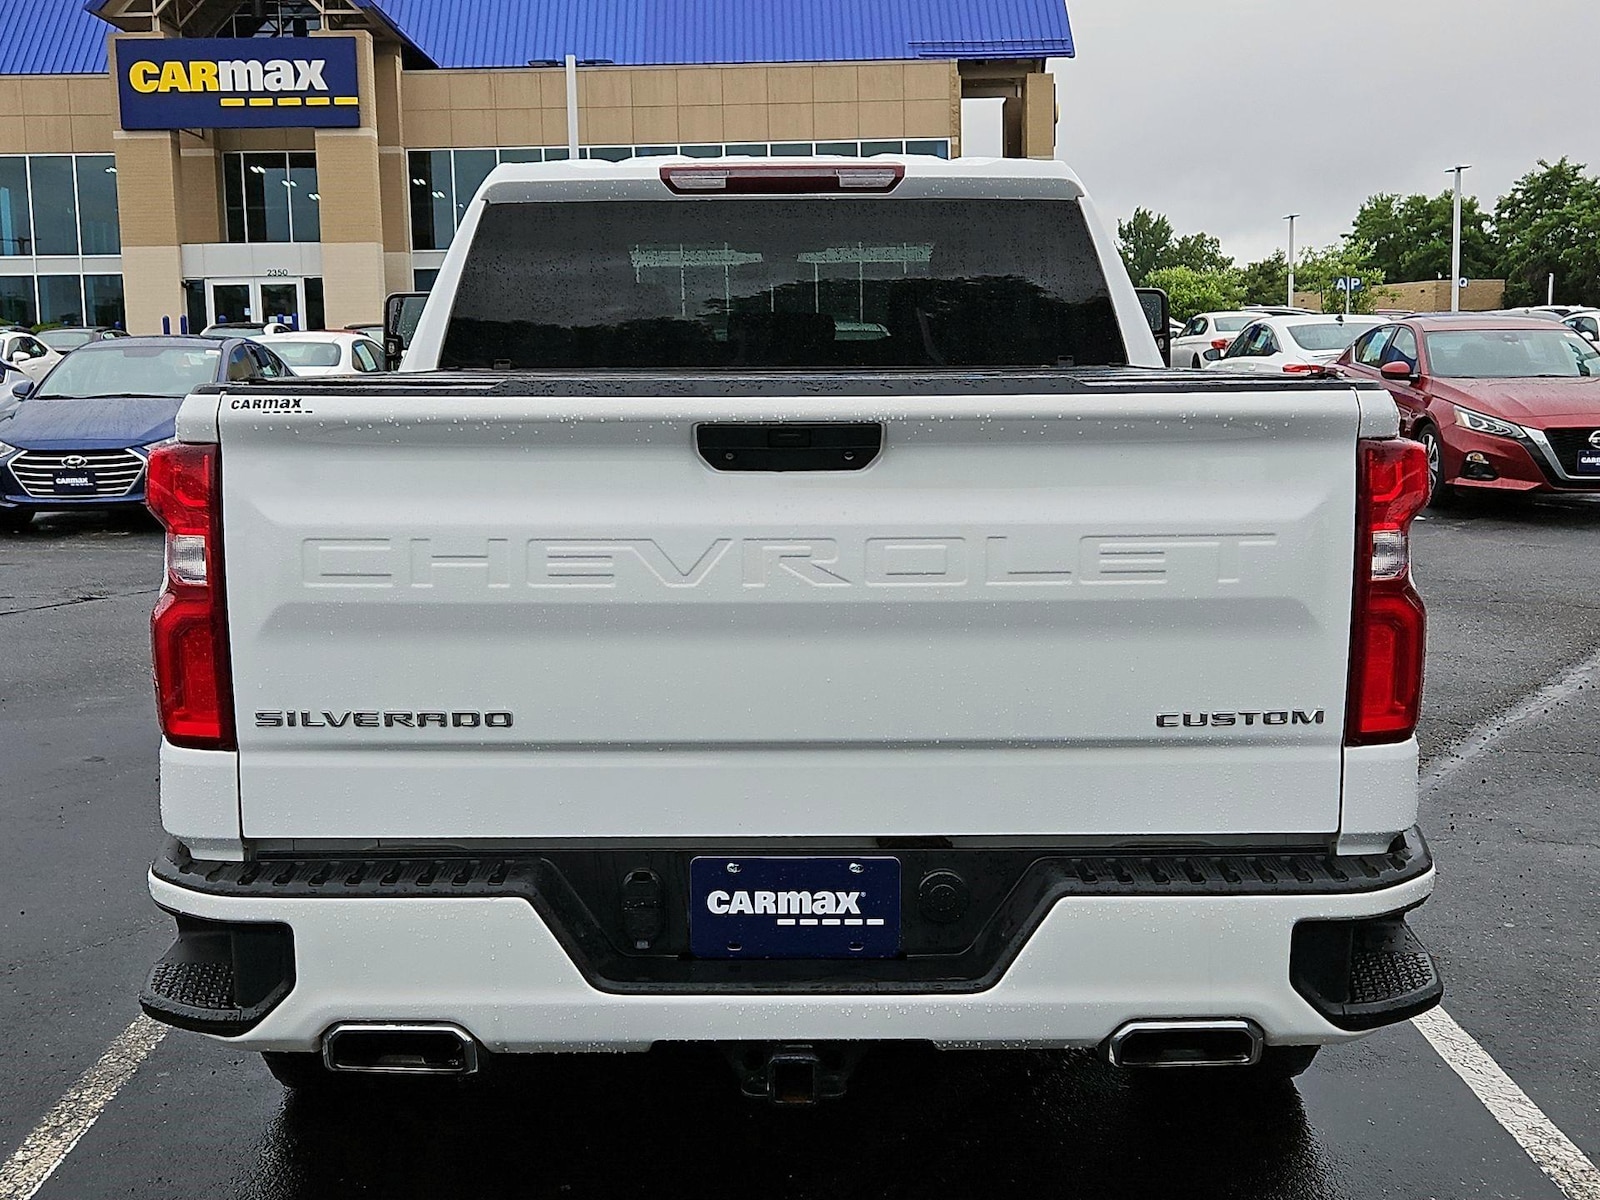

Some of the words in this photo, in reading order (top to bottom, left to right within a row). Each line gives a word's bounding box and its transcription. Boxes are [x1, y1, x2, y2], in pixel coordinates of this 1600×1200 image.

[129, 59, 329, 93] CARmax
[267, 269, 288, 277] 2350
[1336, 278, 1346, 290] A
[1350, 278, 1361, 290] P
[302, 532, 1278, 589] CHEVROLET
[255, 709, 514, 728] SILVERADO
[1156, 709, 1325, 728] CUSTOM
